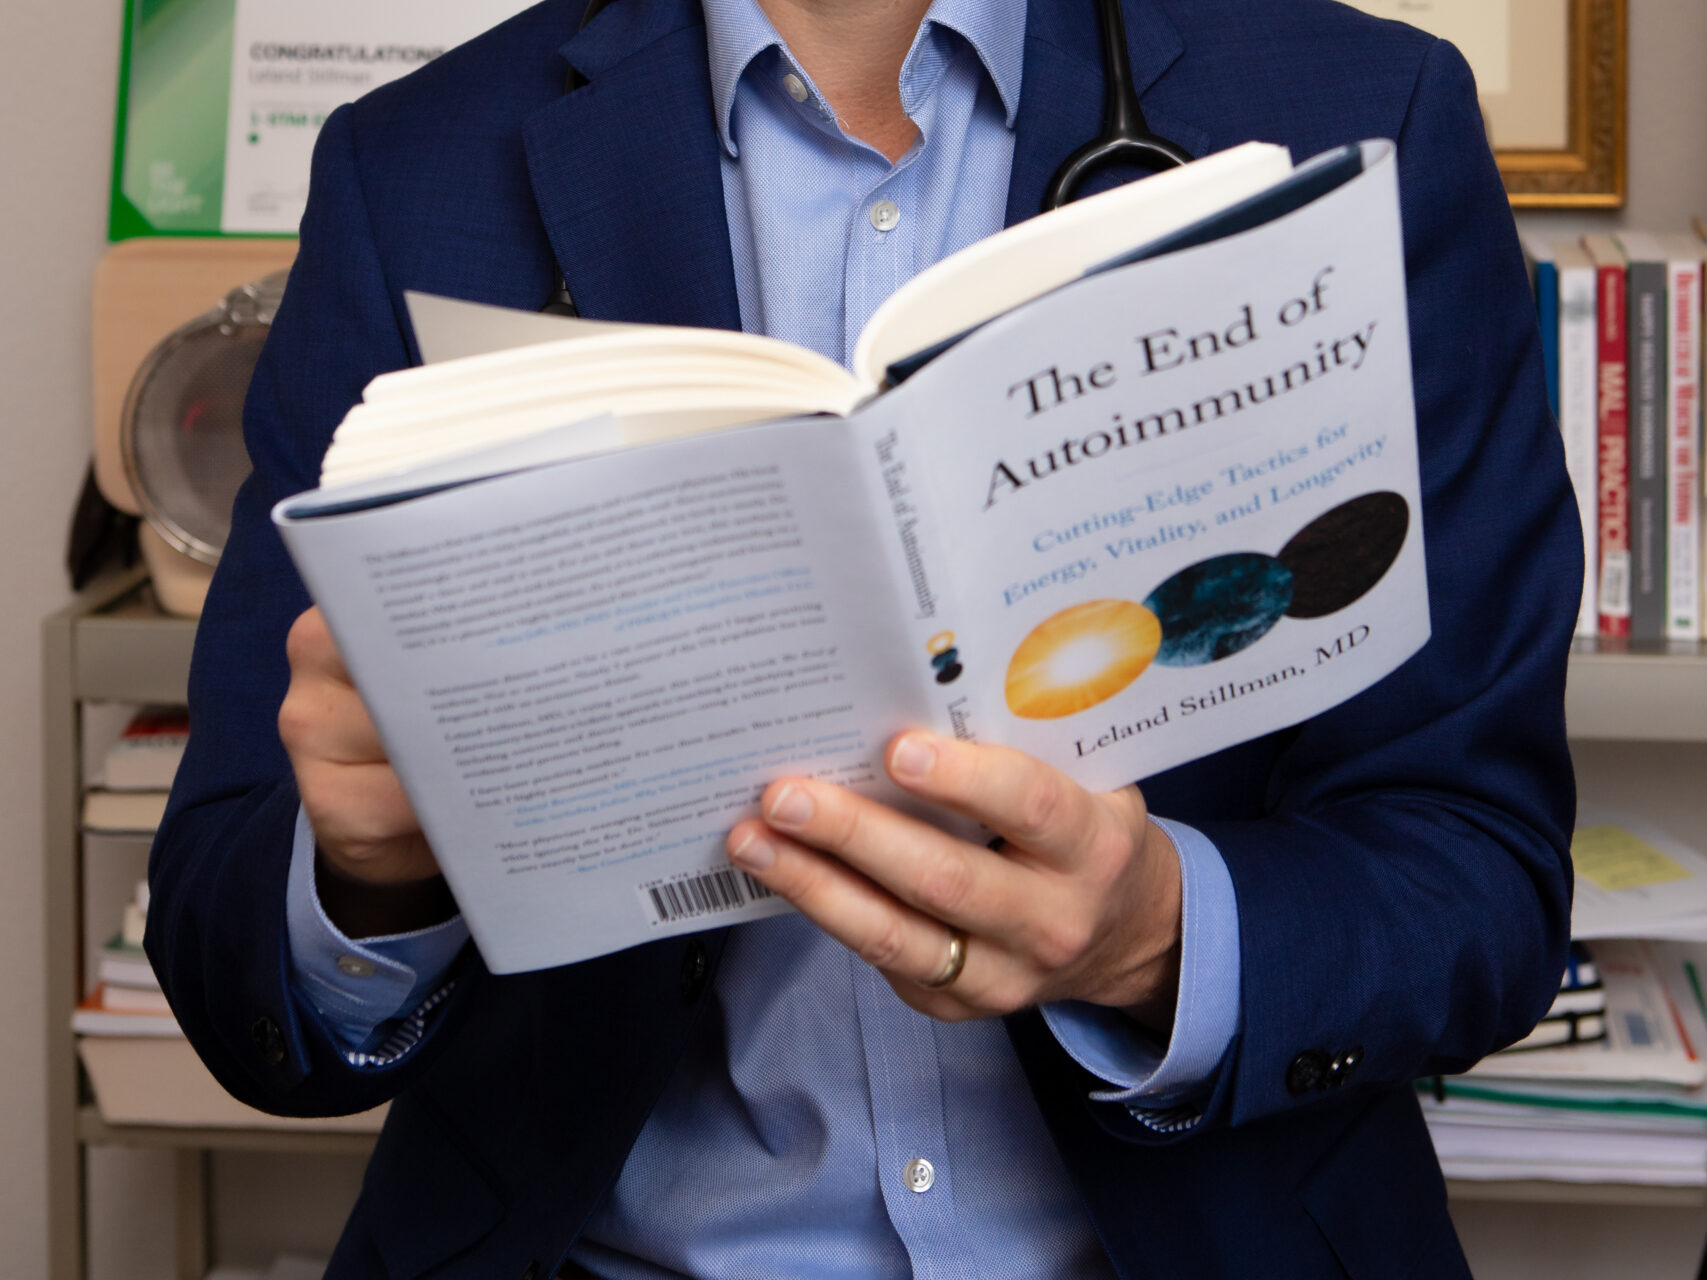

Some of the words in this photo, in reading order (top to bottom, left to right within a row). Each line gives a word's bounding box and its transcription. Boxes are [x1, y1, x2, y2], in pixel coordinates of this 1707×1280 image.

[1008, 361, 1117, 419] The
[1137, 305, 1259, 377] End
[1279, 266, 1334, 327] of
[875, 428, 898, 465] The
[882, 461, 909, 497] End
[983, 321, 1378, 511] Autoimmunity
[893, 498, 917, 517] of
[1003, 557, 1097, 607] Energy,
[1106, 520, 1208, 565] Vitality,
[1216, 494, 1262, 526] and
[1272, 435, 1388, 506] Longevity
[1032, 480, 1213, 555] Cutting-Edge
[1220, 449, 1307, 488] Tactics
[1315, 422, 1350, 454] for
[897, 518, 937, 621] Autoimmunity
[1074, 707, 1170, 759] Leland
[1180, 661, 1305, 716] Stillman,
[1315, 624, 1371, 665] MD
